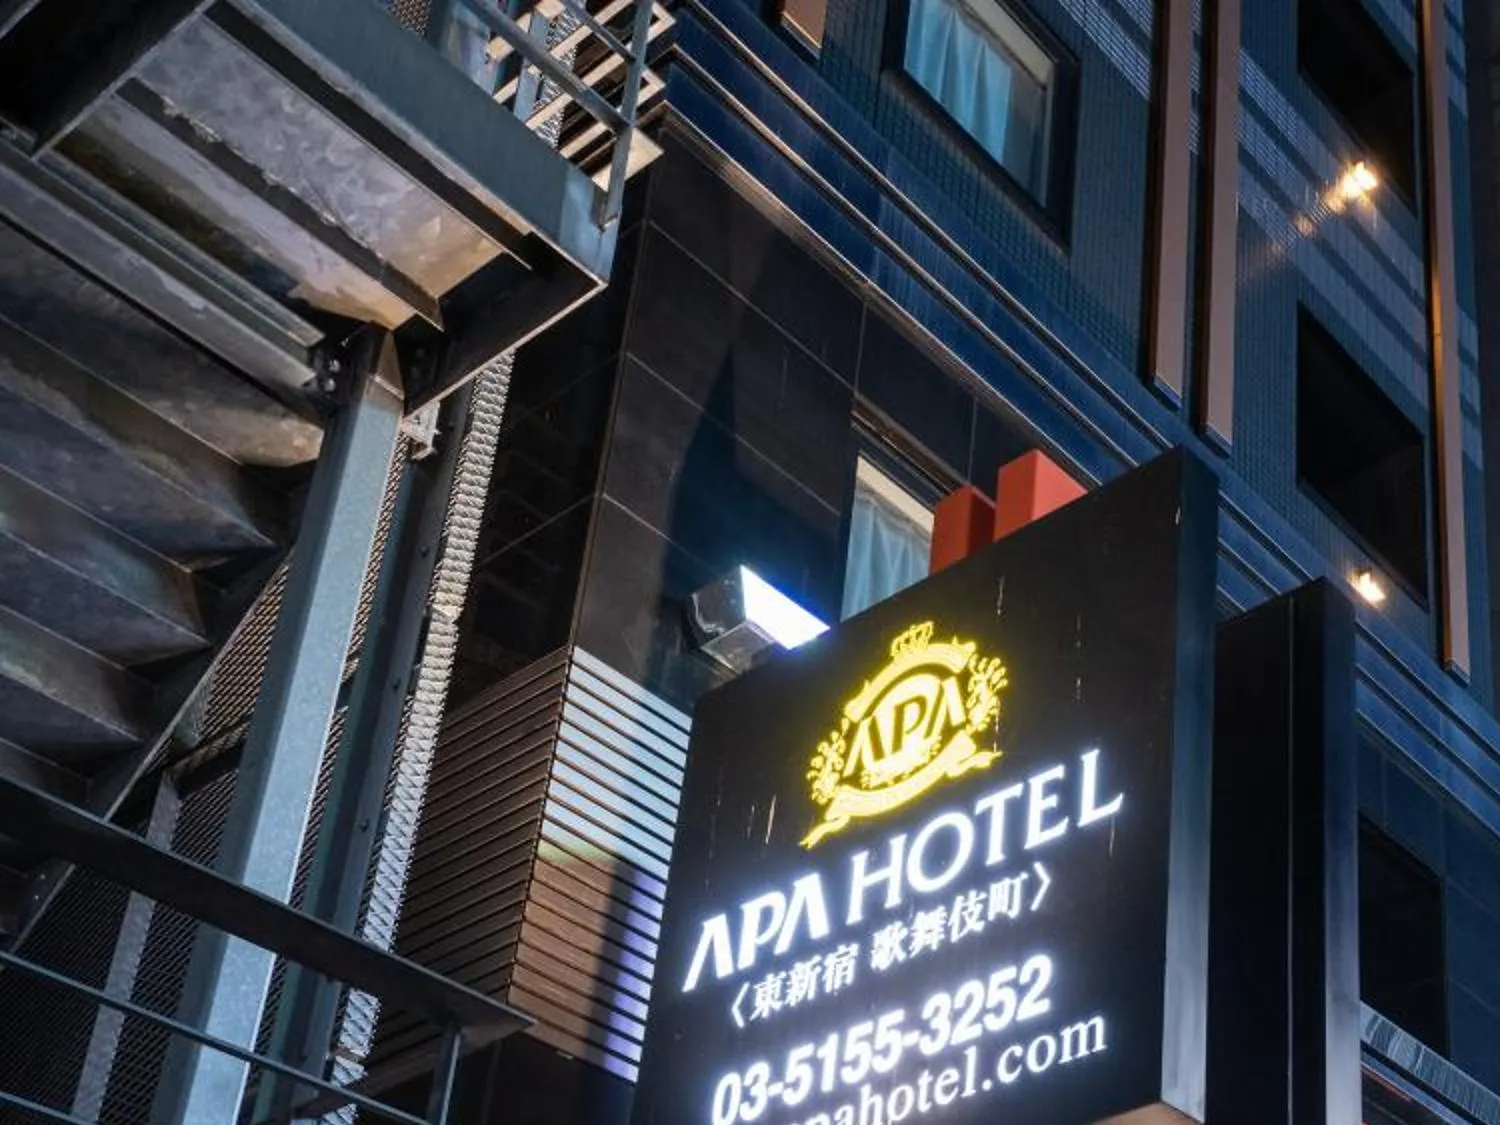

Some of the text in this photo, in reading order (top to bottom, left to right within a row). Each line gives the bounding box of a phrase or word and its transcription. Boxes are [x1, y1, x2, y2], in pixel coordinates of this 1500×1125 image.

[843, 676, 967, 778] APA
[684, 749, 1124, 992] APA HOTEL
